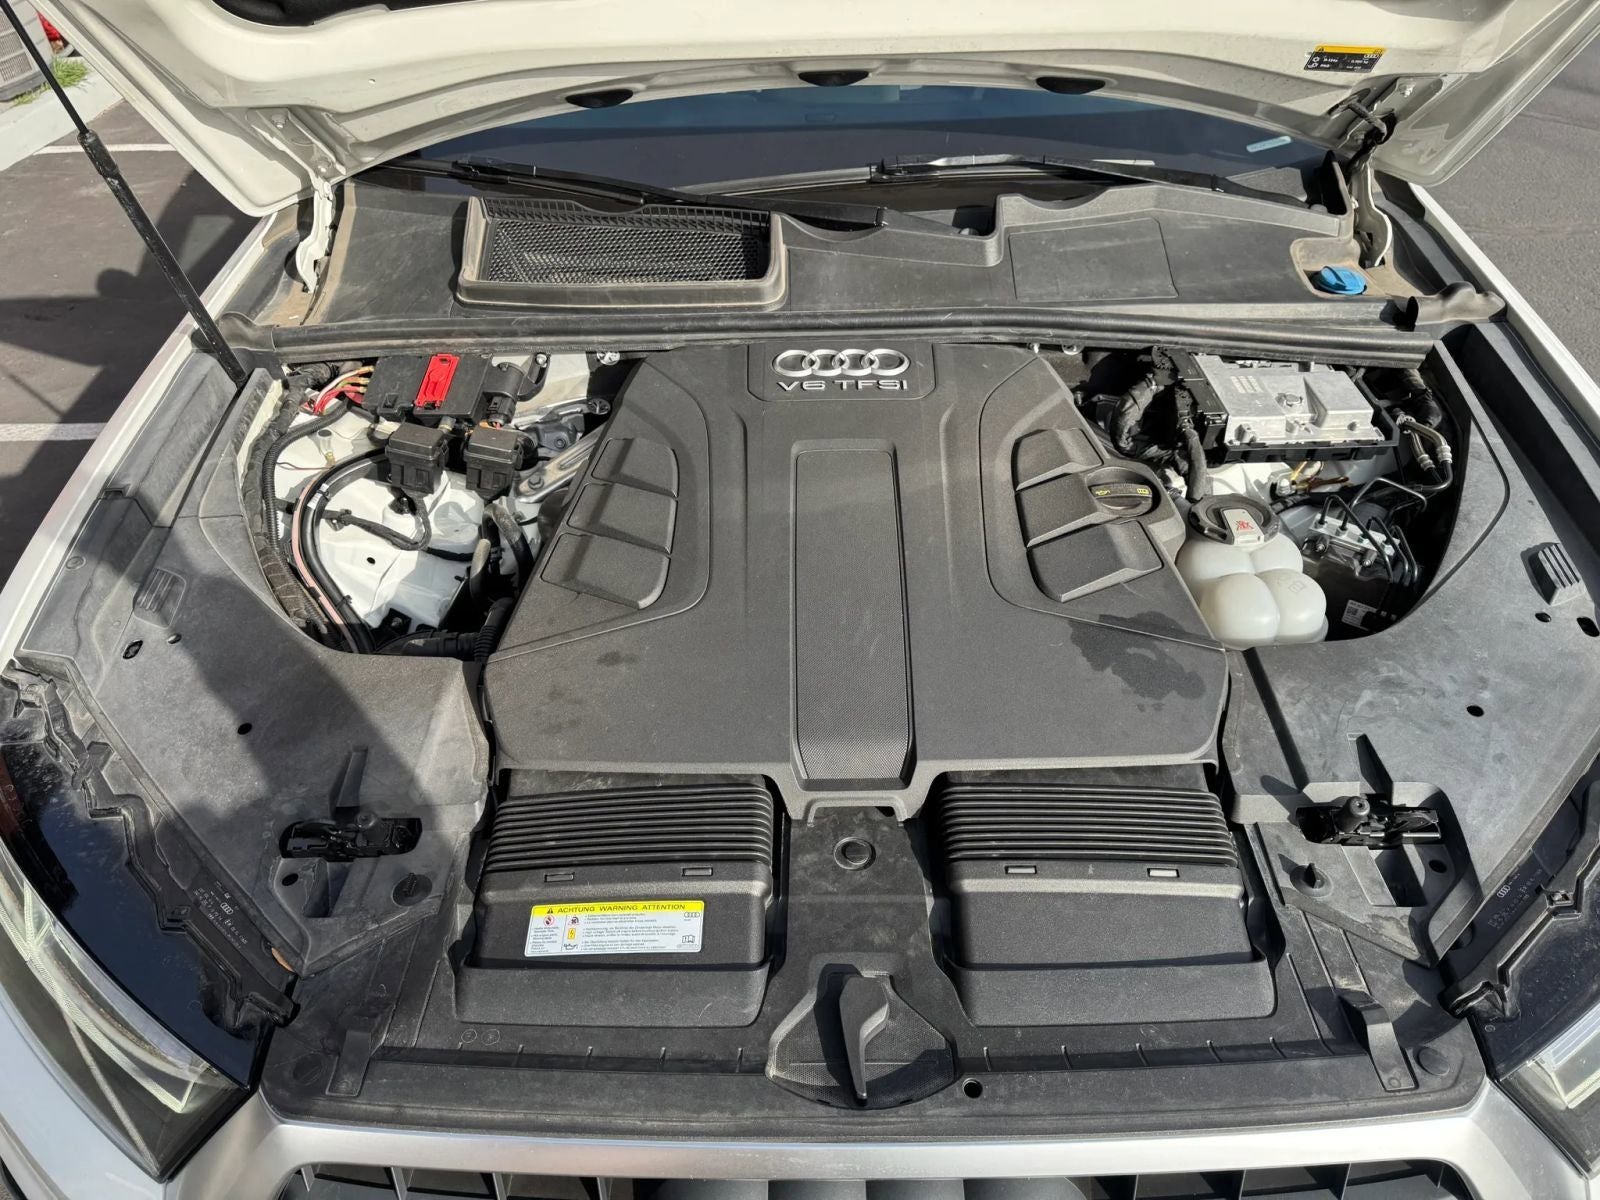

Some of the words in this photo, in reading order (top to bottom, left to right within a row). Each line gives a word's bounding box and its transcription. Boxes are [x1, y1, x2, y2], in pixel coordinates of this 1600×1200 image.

[778, 380, 826, 391] V6
[834, 379, 908, 391] TFSI
[557, 906, 595, 914] ACHTUNG
